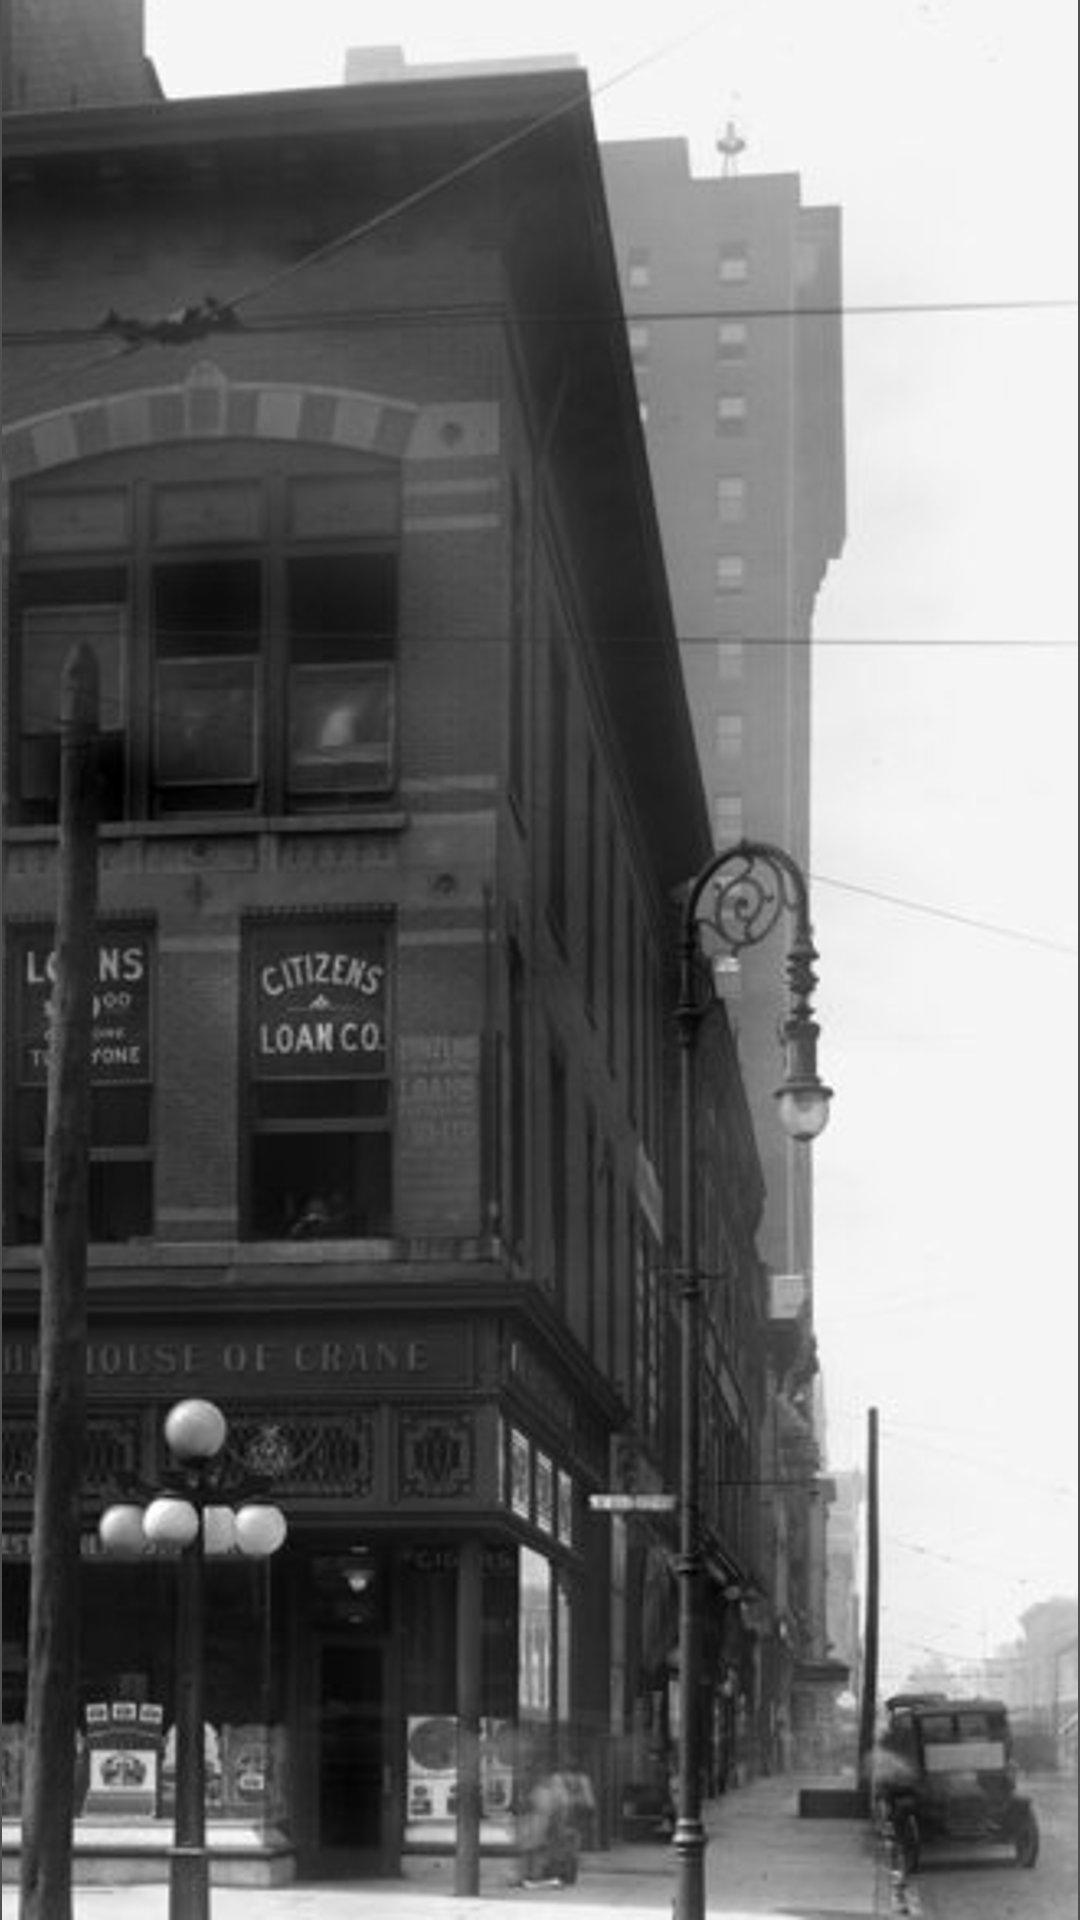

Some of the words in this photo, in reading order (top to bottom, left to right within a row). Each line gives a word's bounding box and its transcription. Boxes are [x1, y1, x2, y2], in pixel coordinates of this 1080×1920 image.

[27, 946, 143, 983] LONS
[262, 951, 384, 996] CITIZENS
[260, 1022, 334, 1054] LOAN
[223, 1342, 283, 1372] OF
[294, 1339, 429, 1372] CRANE
